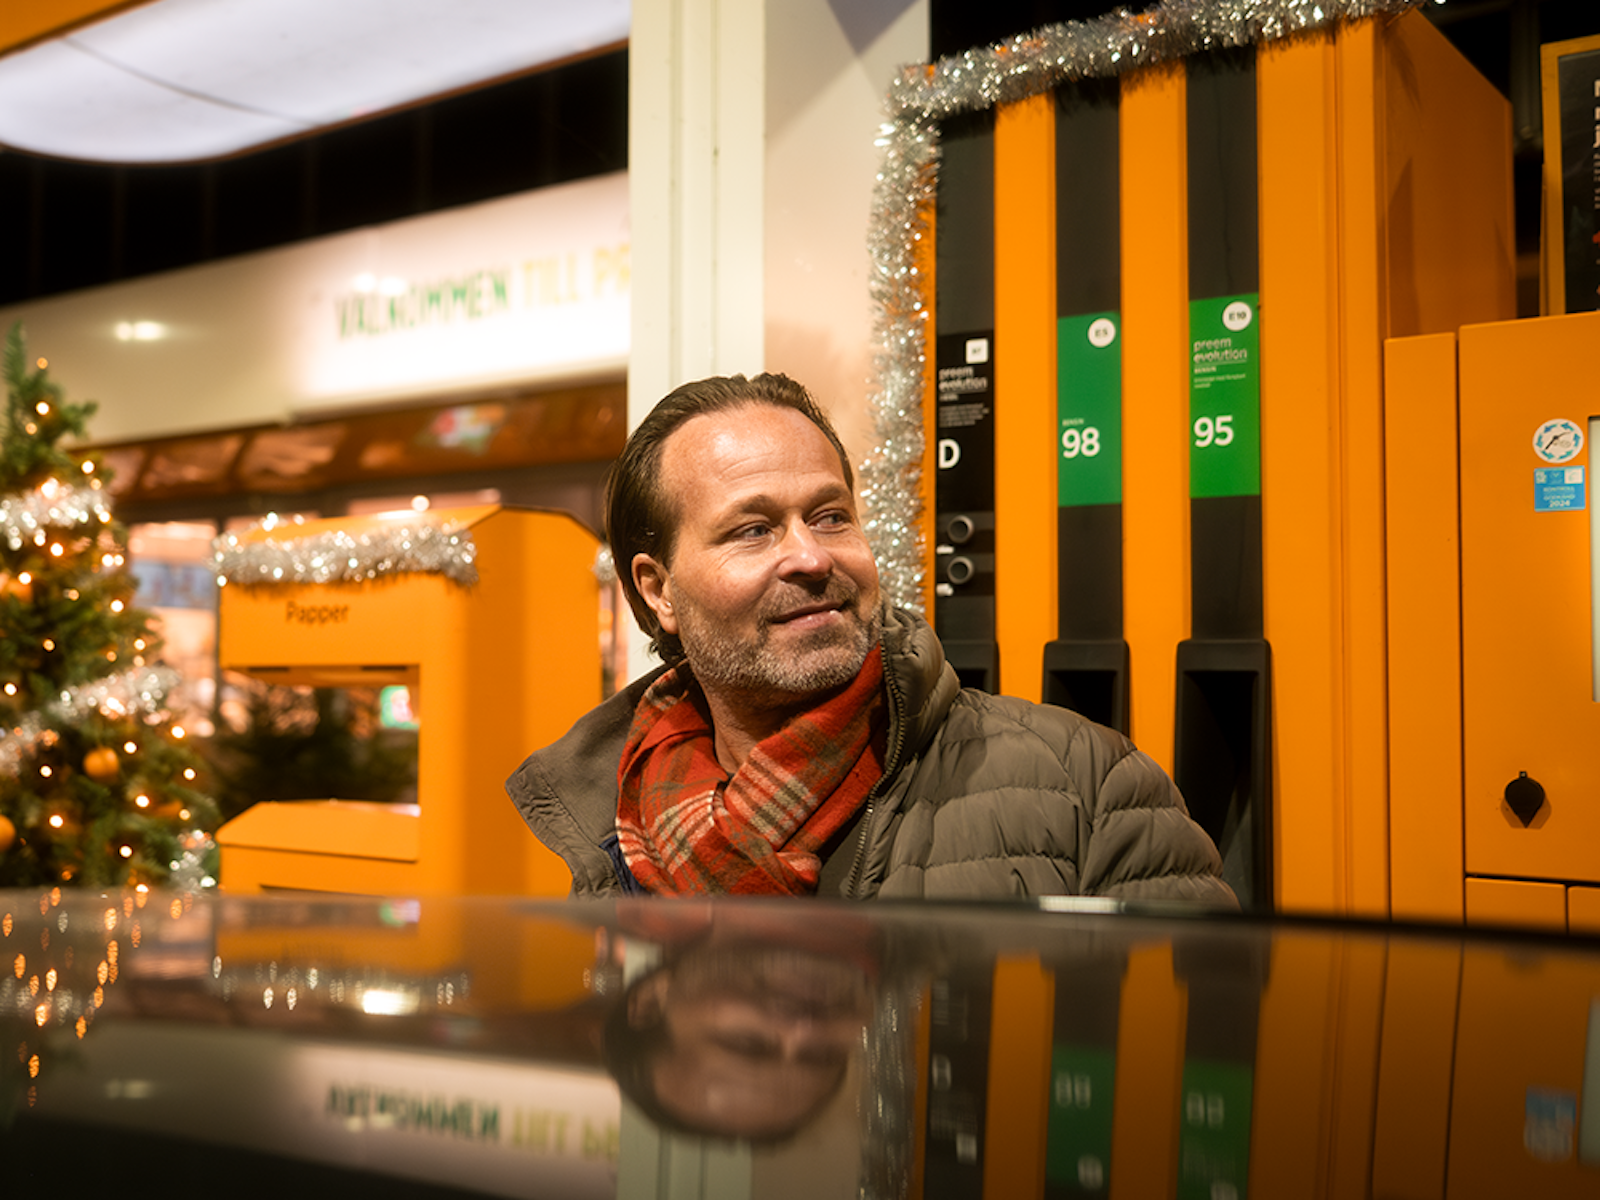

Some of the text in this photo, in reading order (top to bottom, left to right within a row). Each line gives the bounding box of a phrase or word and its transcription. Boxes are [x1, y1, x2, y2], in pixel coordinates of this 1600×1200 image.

[1193, 337, 1232, 353] preem
[1193, 348, 1248, 364] evolution
[938, 365, 975, 381] preem
[938, 377, 989, 393] evolution
[1193, 415, 1235, 448] 95
[1061, 426, 1101, 459] 98
[938, 438, 961, 470] D
[1549, 499, 1571, 508] 2024
[284, 600, 350, 628] Papper
